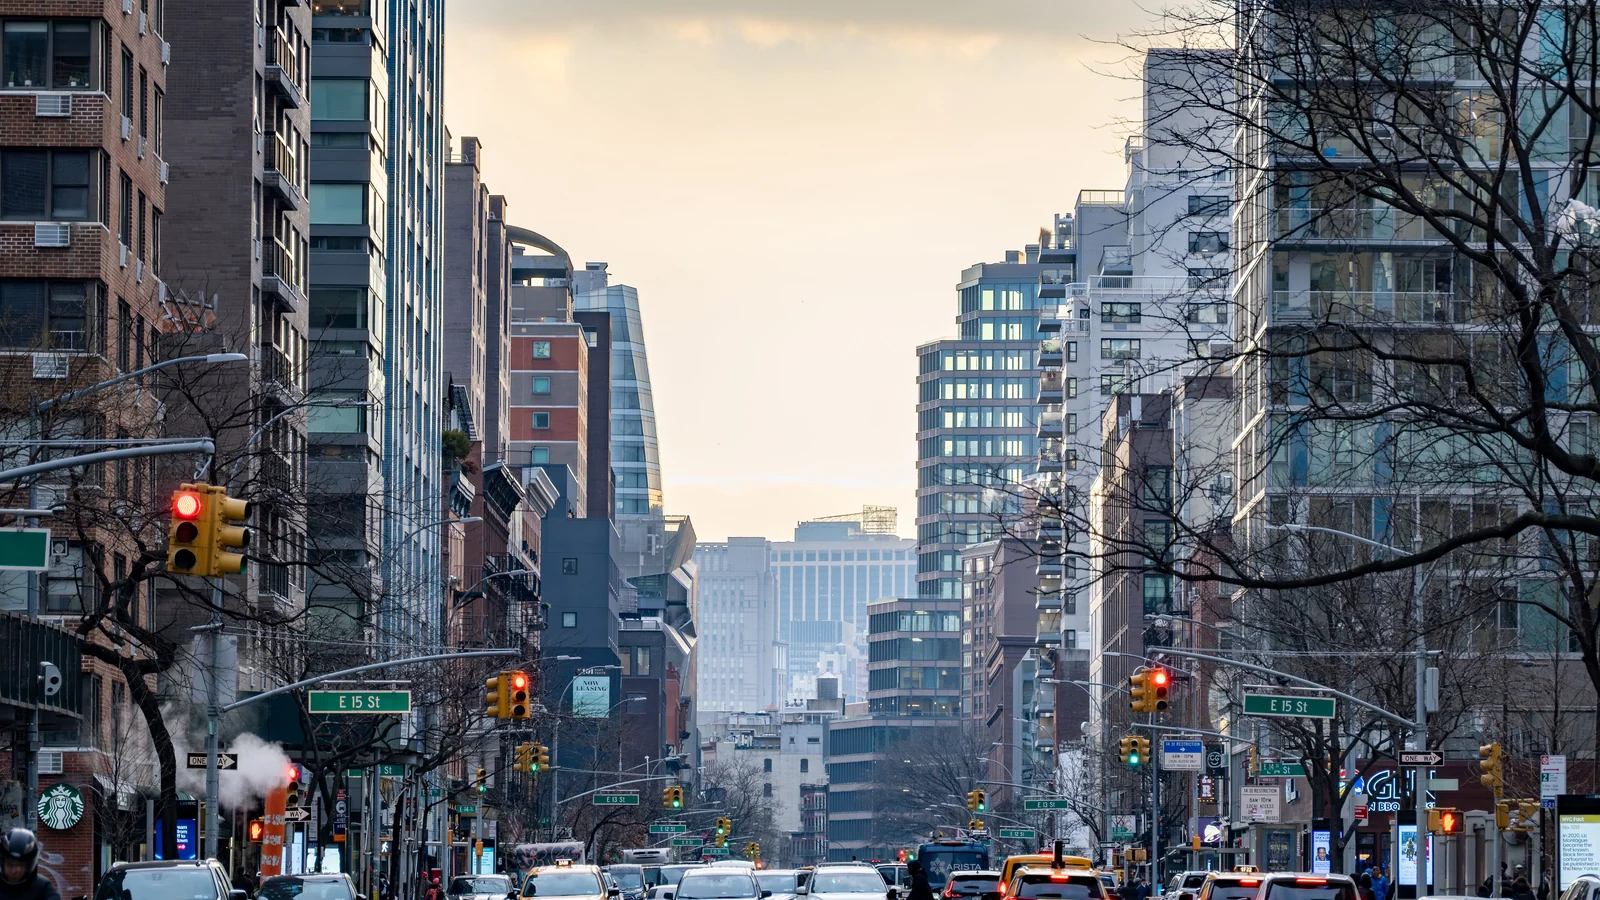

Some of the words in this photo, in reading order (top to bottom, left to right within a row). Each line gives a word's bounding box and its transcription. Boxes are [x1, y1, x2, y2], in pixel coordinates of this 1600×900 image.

[340, 696, 346, 708] E
[352, 696, 362, 708] 15
[368, 696, 380, 708] St
[1271, 700, 1277, 711] E
[1282, 700, 1292, 712] 15
[1296, 701, 1308, 712] St
[1283, 766, 1290, 774] St
[1378, 802, 1400, 812] BBQ
